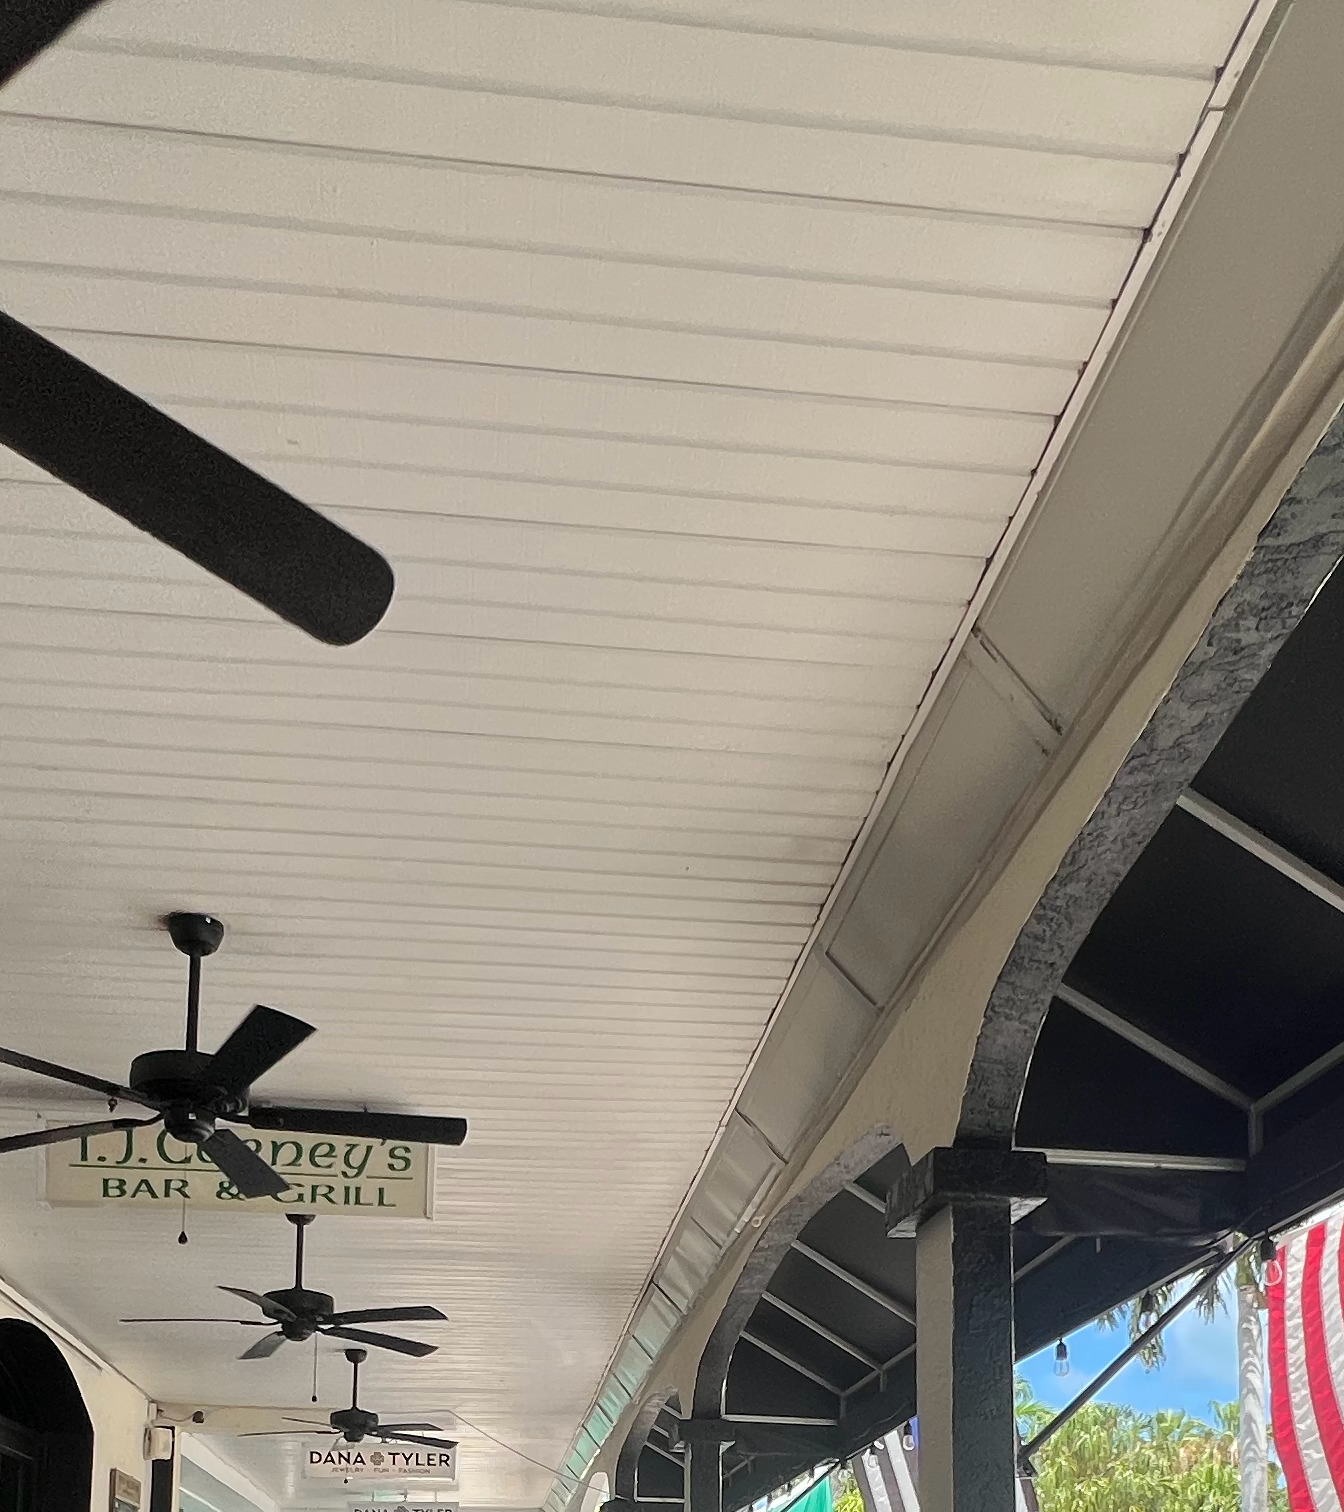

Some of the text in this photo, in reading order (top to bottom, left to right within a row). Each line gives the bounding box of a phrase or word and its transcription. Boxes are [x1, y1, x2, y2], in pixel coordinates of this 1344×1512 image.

[156, 1129, 412, 1179] Cney's
[102, 1177, 191, 1199] BAR
[269, 1182, 397, 1208] GRILL
[309, 1450, 451, 1468] DANA TYLER
[398, 1467, 431, 1475] FASHION
